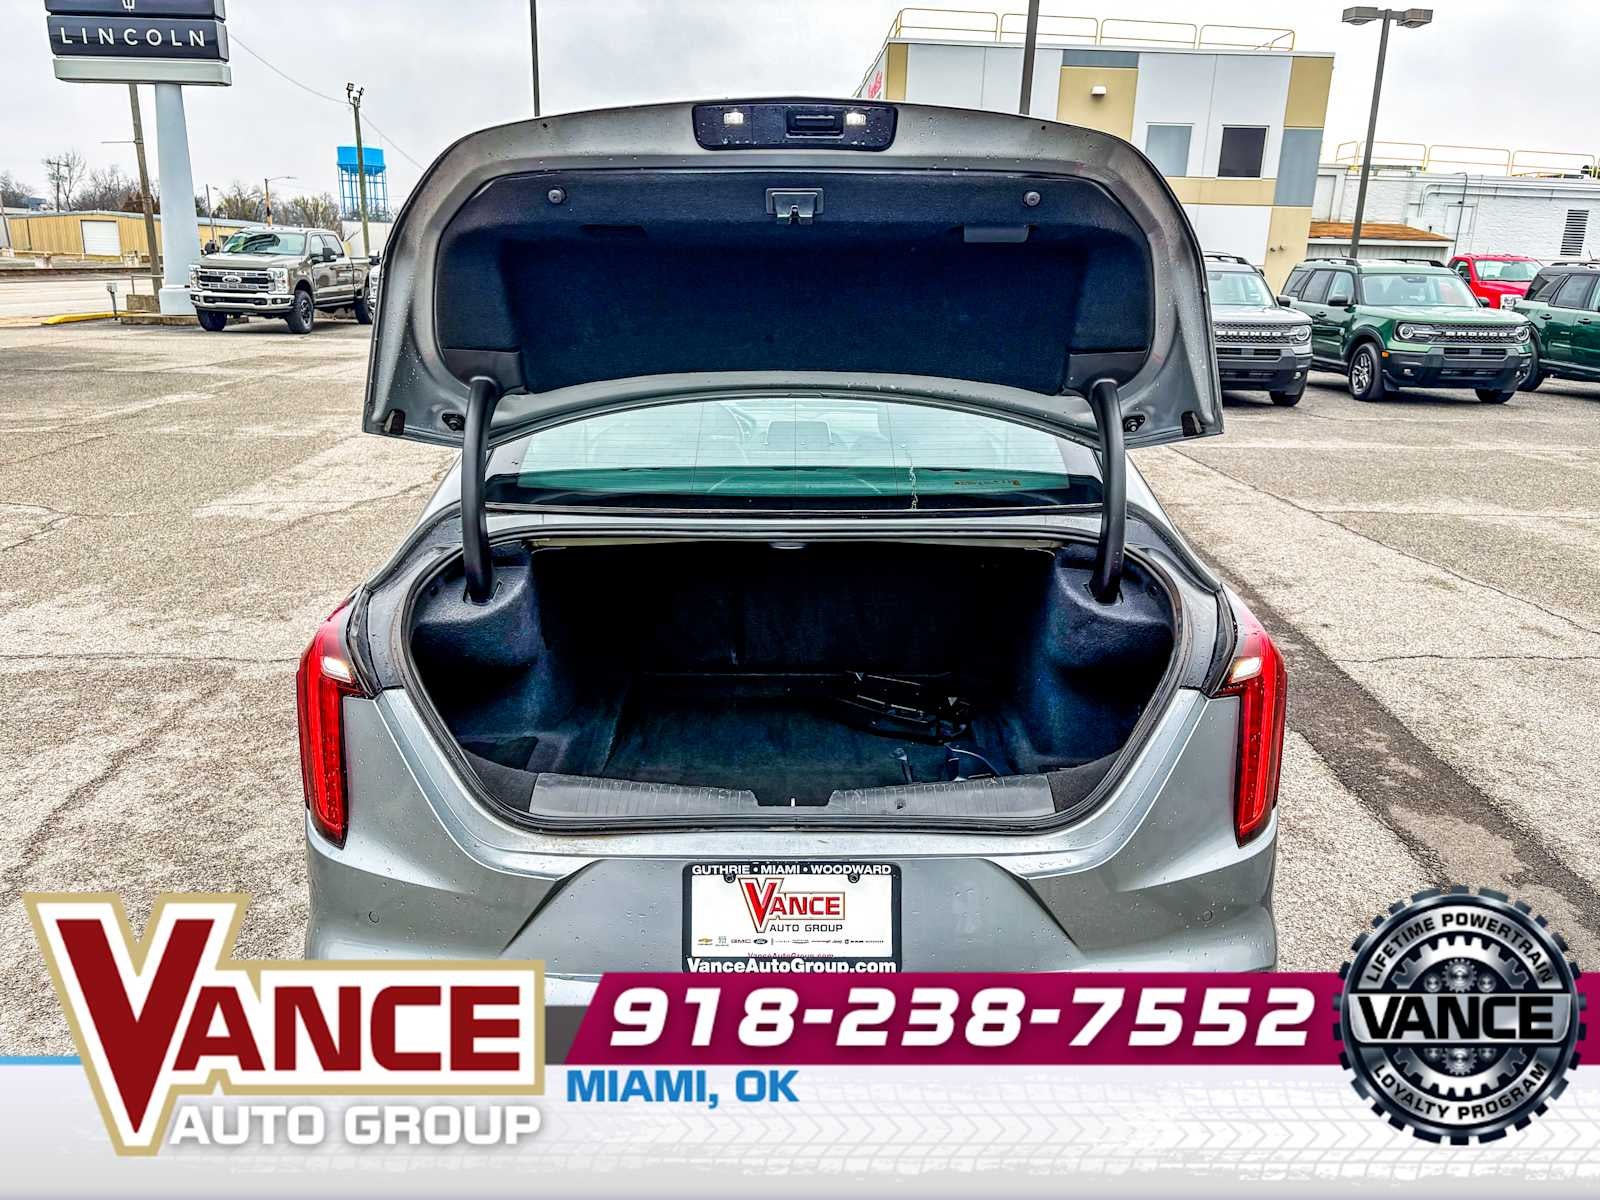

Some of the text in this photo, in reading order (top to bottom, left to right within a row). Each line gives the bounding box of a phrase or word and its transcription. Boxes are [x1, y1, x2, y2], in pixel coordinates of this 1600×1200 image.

[60, 27, 206, 47] LINCOLN
[692, 865, 892, 875] GUTHRIE MIAMI WOODWARD
[744, 882, 841, 929] VANCE
[769, 924, 843, 932] AUTO GROUP
[687, 958, 897, 973] VanceAutoGroup.com
